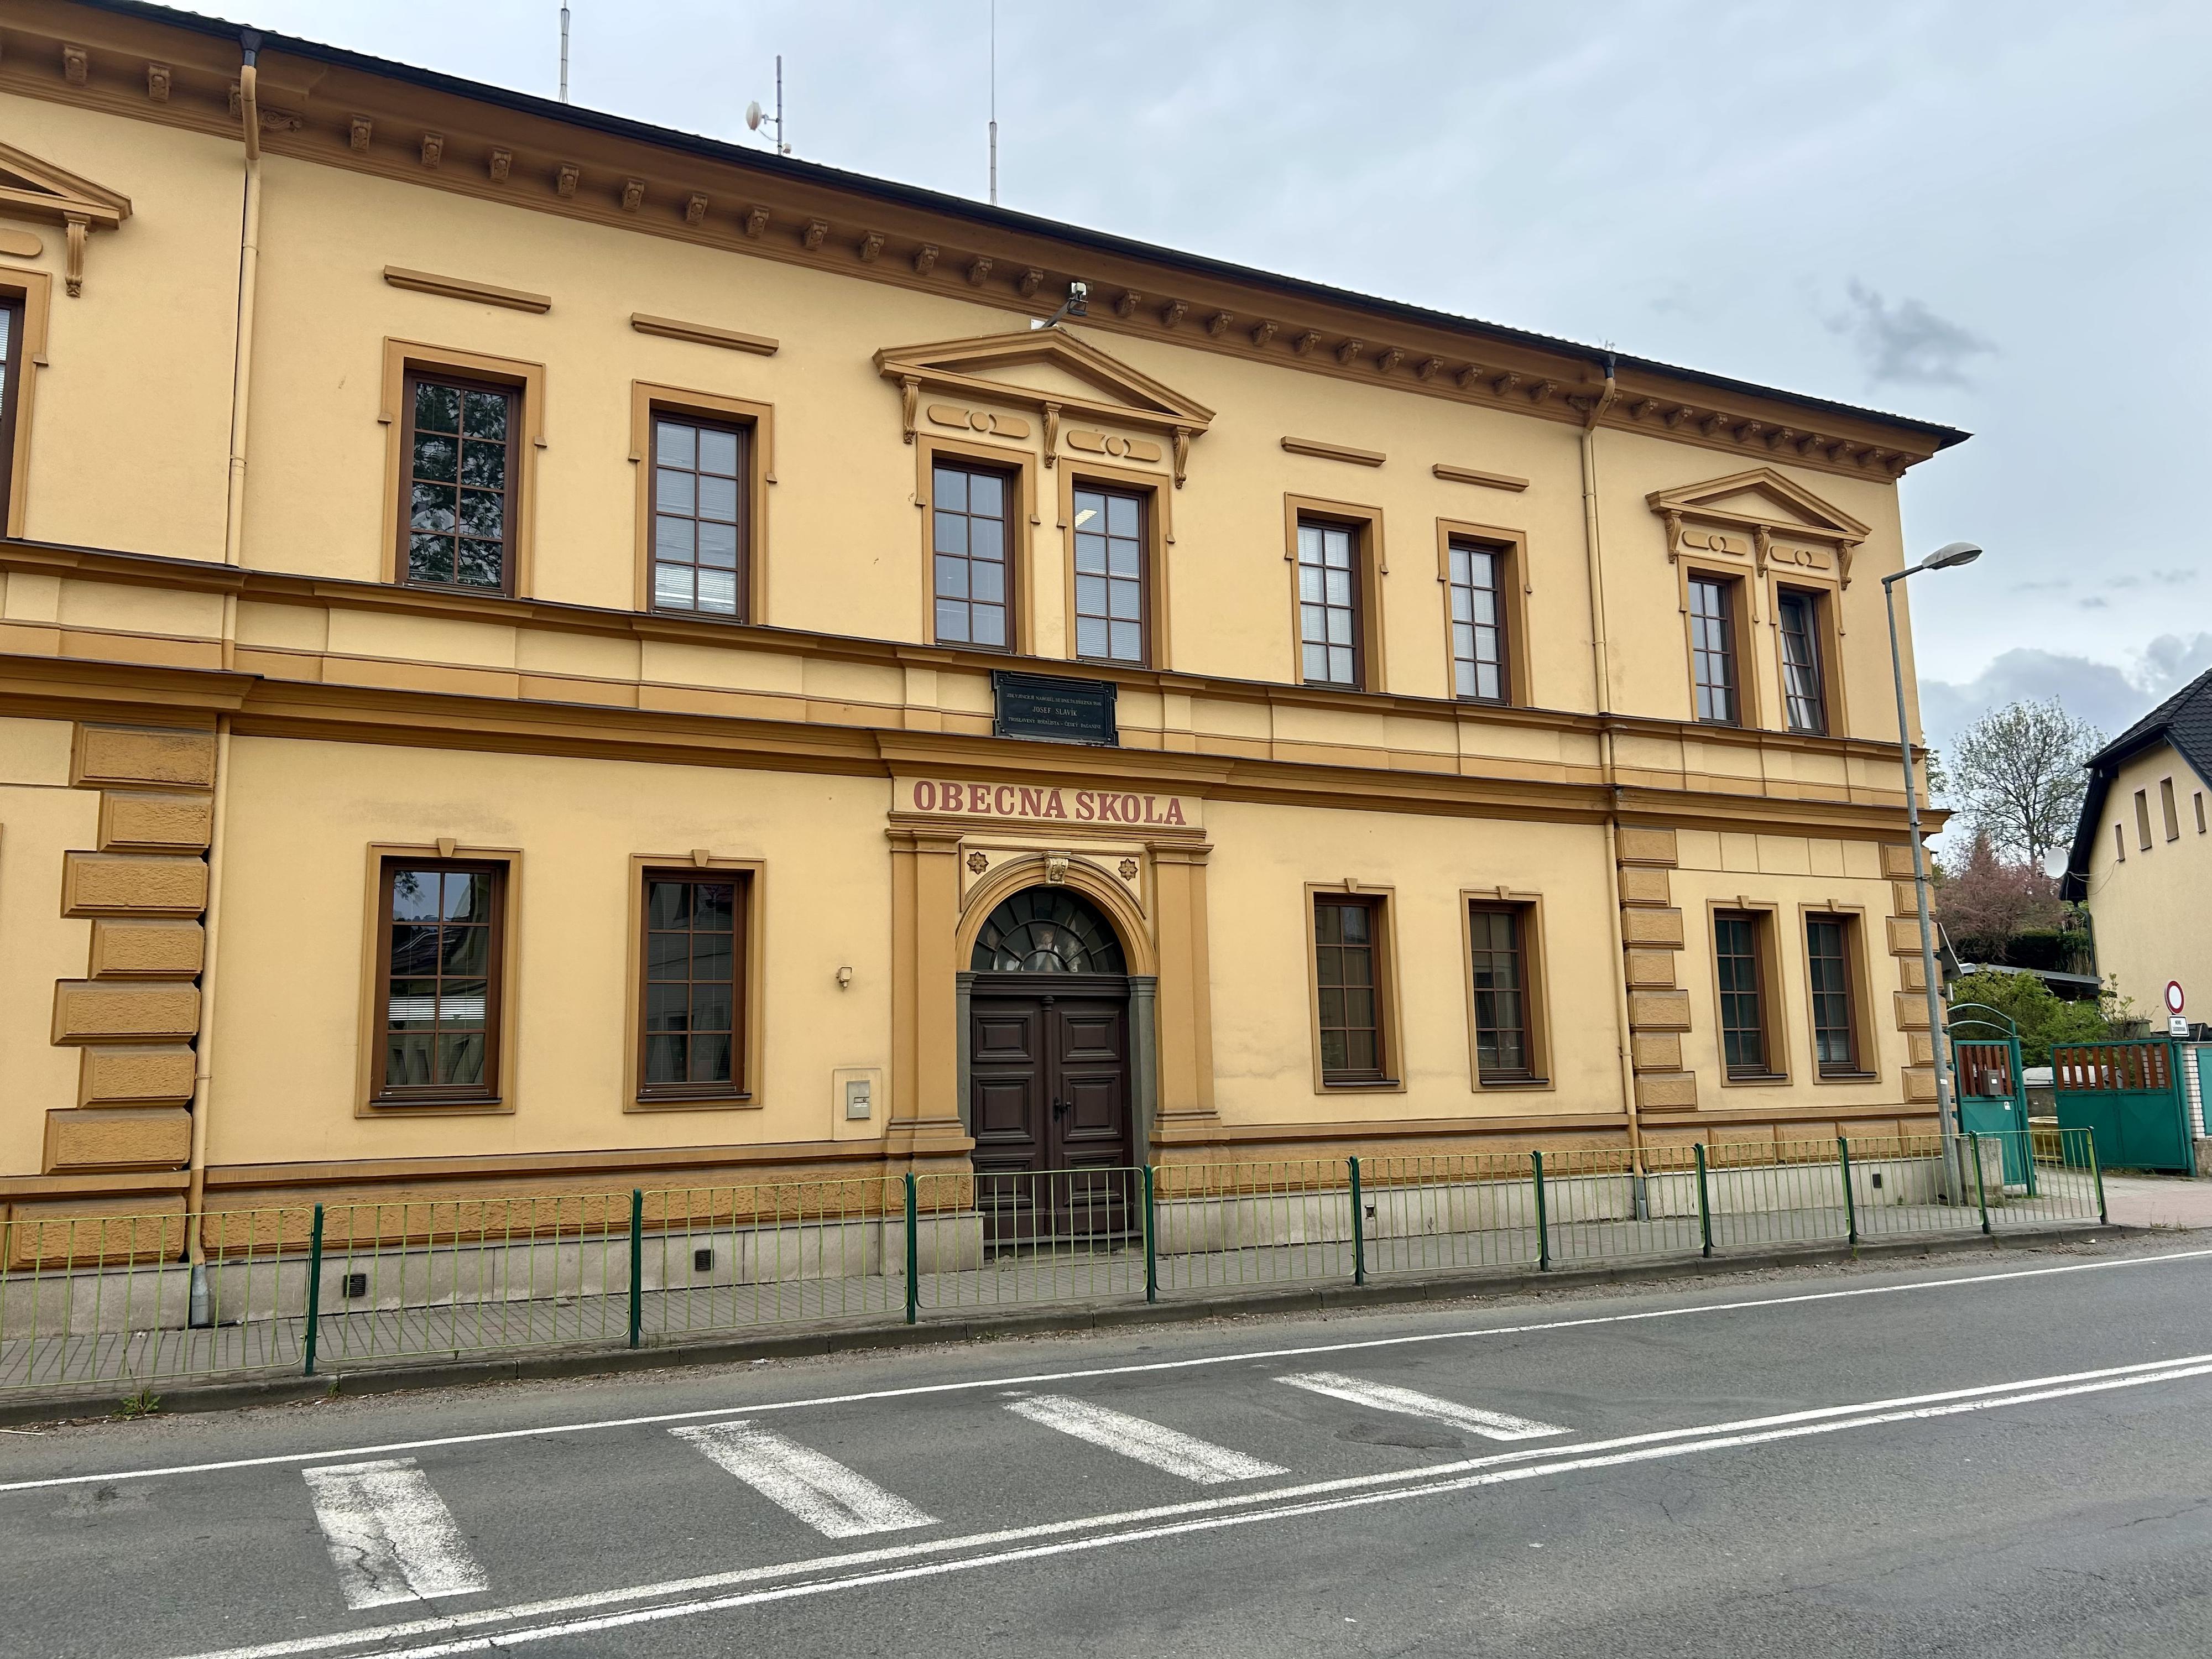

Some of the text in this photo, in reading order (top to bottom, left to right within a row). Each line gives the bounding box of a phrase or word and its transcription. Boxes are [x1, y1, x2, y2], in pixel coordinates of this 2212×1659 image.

[1055, 708, 1077, 716] SLAVÍK
[914, 781, 1186, 825] OBECNÁ ŠKOLA
